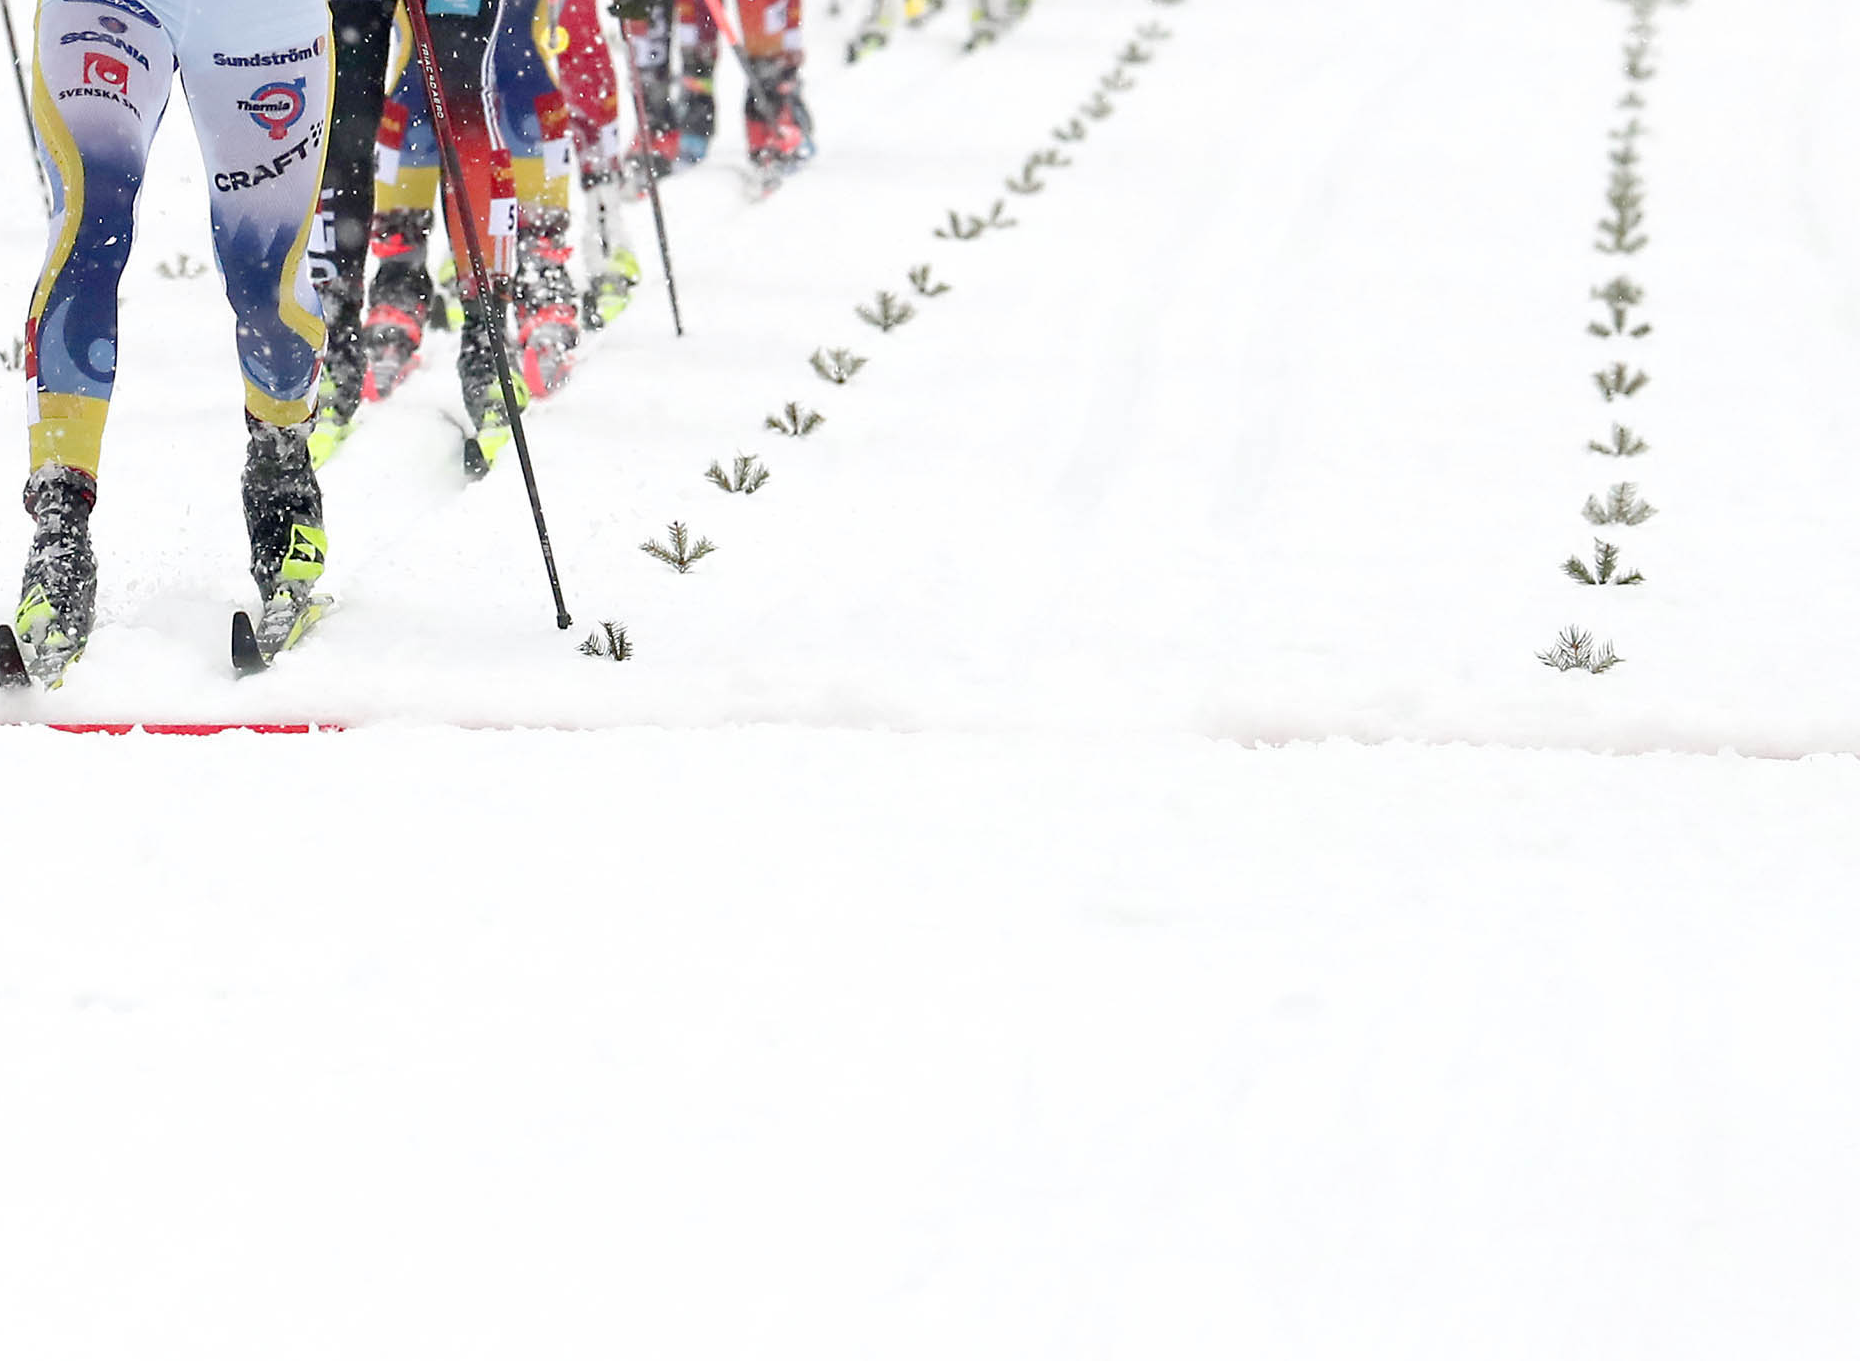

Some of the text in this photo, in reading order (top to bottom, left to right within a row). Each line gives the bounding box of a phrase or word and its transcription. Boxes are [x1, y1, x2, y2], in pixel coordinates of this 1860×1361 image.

[212, 44, 313, 68] Sundström
[58, 87, 120, 103] SVENSKA
[236, 99, 291, 113] Thermia
[213, 137, 310, 193] CRAFT
